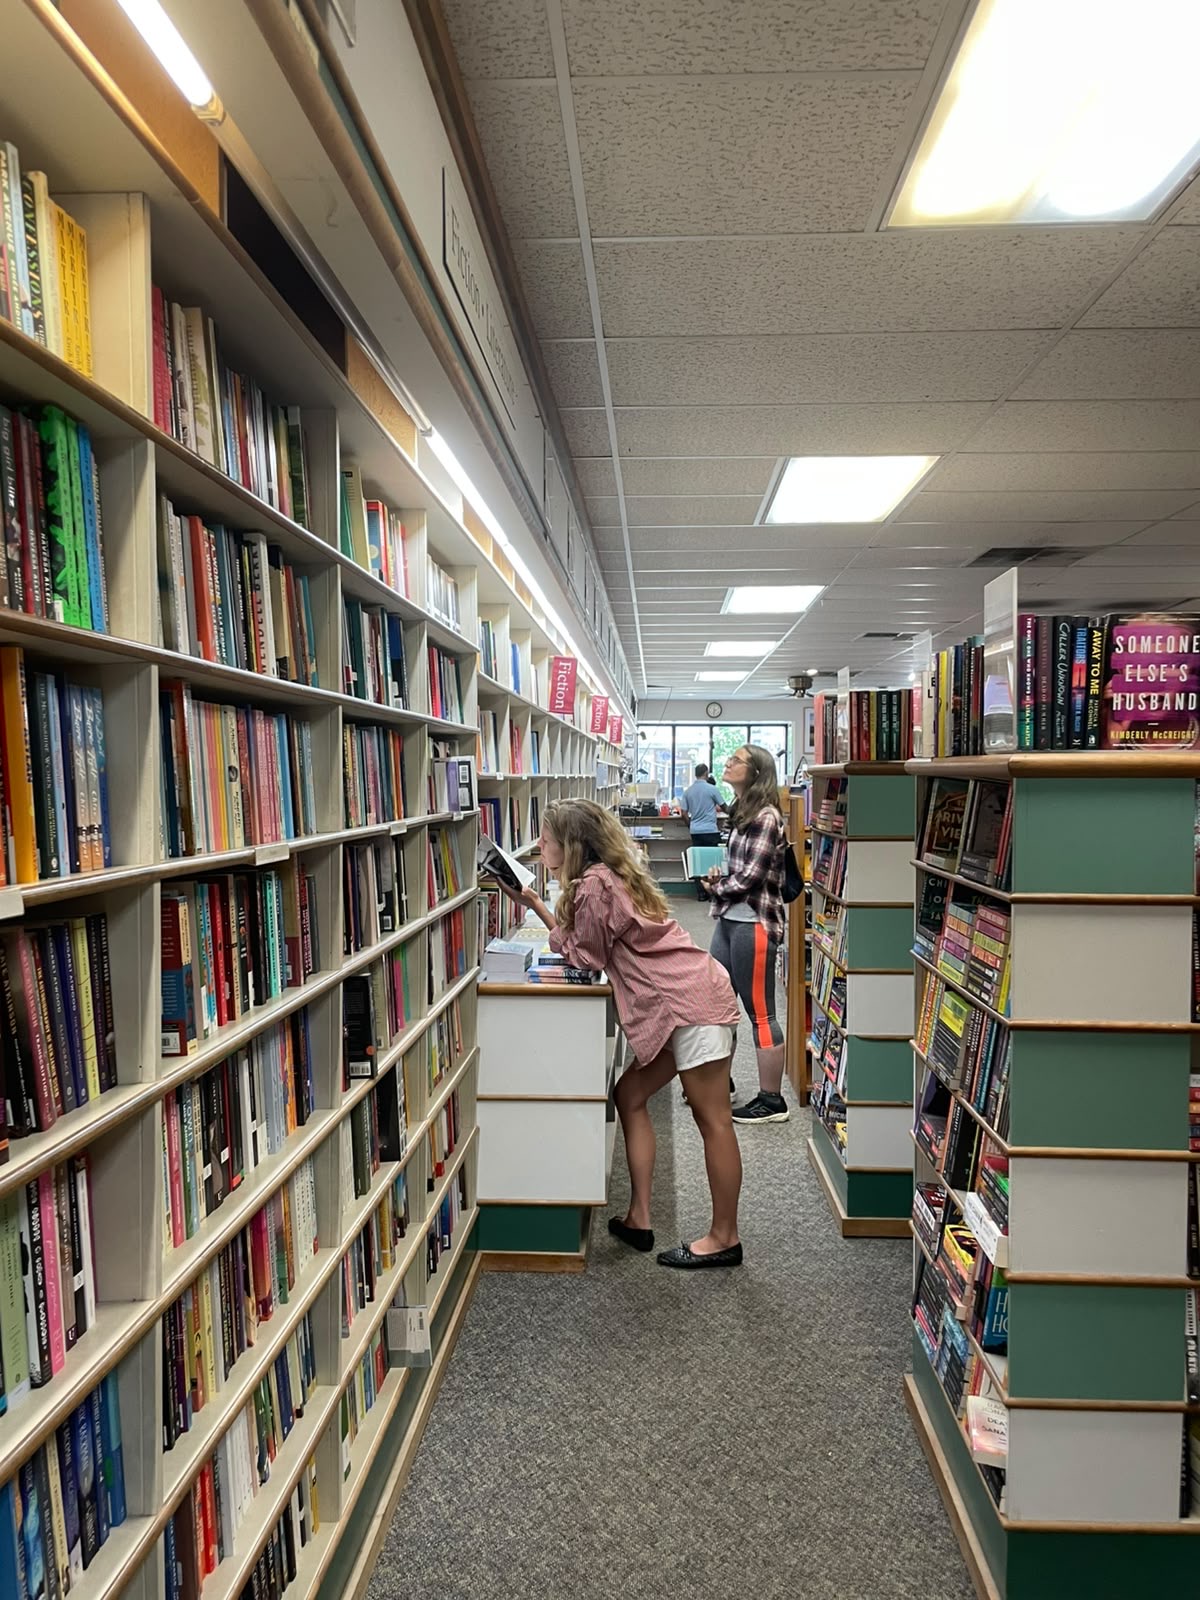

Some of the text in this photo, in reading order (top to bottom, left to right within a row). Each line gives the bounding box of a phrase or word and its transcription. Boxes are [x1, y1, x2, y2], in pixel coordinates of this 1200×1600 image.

[3, 193, 14, 252] AVENUE
[22, 181, 43, 318] CONFESSIONS
[450, 204, 518, 406] Fiction Literature
[2, 417, 10, 440] big
[5, 446, 14, 470] girl
[7, 477, 15, 507] blitz
[29, 530, 37, 570] NAVESSA
[40, 533, 49, 572] NAVESSA
[206, 554, 214, 596] WOMEN
[213, 556, 221, 600] WOMEN
[251, 542, 266, 674] WENDELL BERRY
[1059, 622, 1070, 660] CALLER
[1076, 627, 1087, 664] TRAITORS
[1115, 635, 1200, 654] SOMEONE
[1090, 630, 1102, 695] AWAY TO ME
[1125, 664, 1188, 682] ELSE'S
[554, 662, 572, 709] Fiction
[1041, 694, 1047, 702] OF
[1057, 663, 1068, 706] UNKNOWN
[1112, 692, 1197, 711] HUSBAND
[40, 701, 49, 752] MOONSHINE
[73, 700, 84, 745] Barre
[85, 700, 95, 745] Barre
[594, 698, 606, 730] Fiction
[612, 718, 621, 741] Fiction
[1110, 730, 1196, 740] KIMBERLY McCREIGHT
[44, 756, 52, 789] WOMEN
[90, 919, 99, 962] MARGARET
[100, 918, 108, 954] MARGARET
[64, 928, 73, 972] MARGARET
[69, 974, 77, 1011] ATWOOD
[4, 980, 17, 1035] ATKINSON
[47, 928, 69, 1076] MARGARET ATWOOD ALIAS GRACE
[27, 979, 38, 1028] ATKINSON
[36, 1034, 48, 1098] TRANSCRIPTION
[38, 980, 50, 1034] AUTOBIOGRAPHY
[46, 1043, 57, 1077] BENJAMIN
[62, 1228, 70, 1272] PREJUDICE
[6, 1252, 15, 1310] PREJUDICE
[1187, 1340, 1198, 1374] PRONTO
[63, 1430, 72, 1466] BACKMAN
[78, 1424, 96, 1552] BACKMAN WINNERS
[43, 1508, 53, 1531] MAN
[45, 1532, 56, 1568] CALLED
[49, 1570, 58, 1591] OVE
